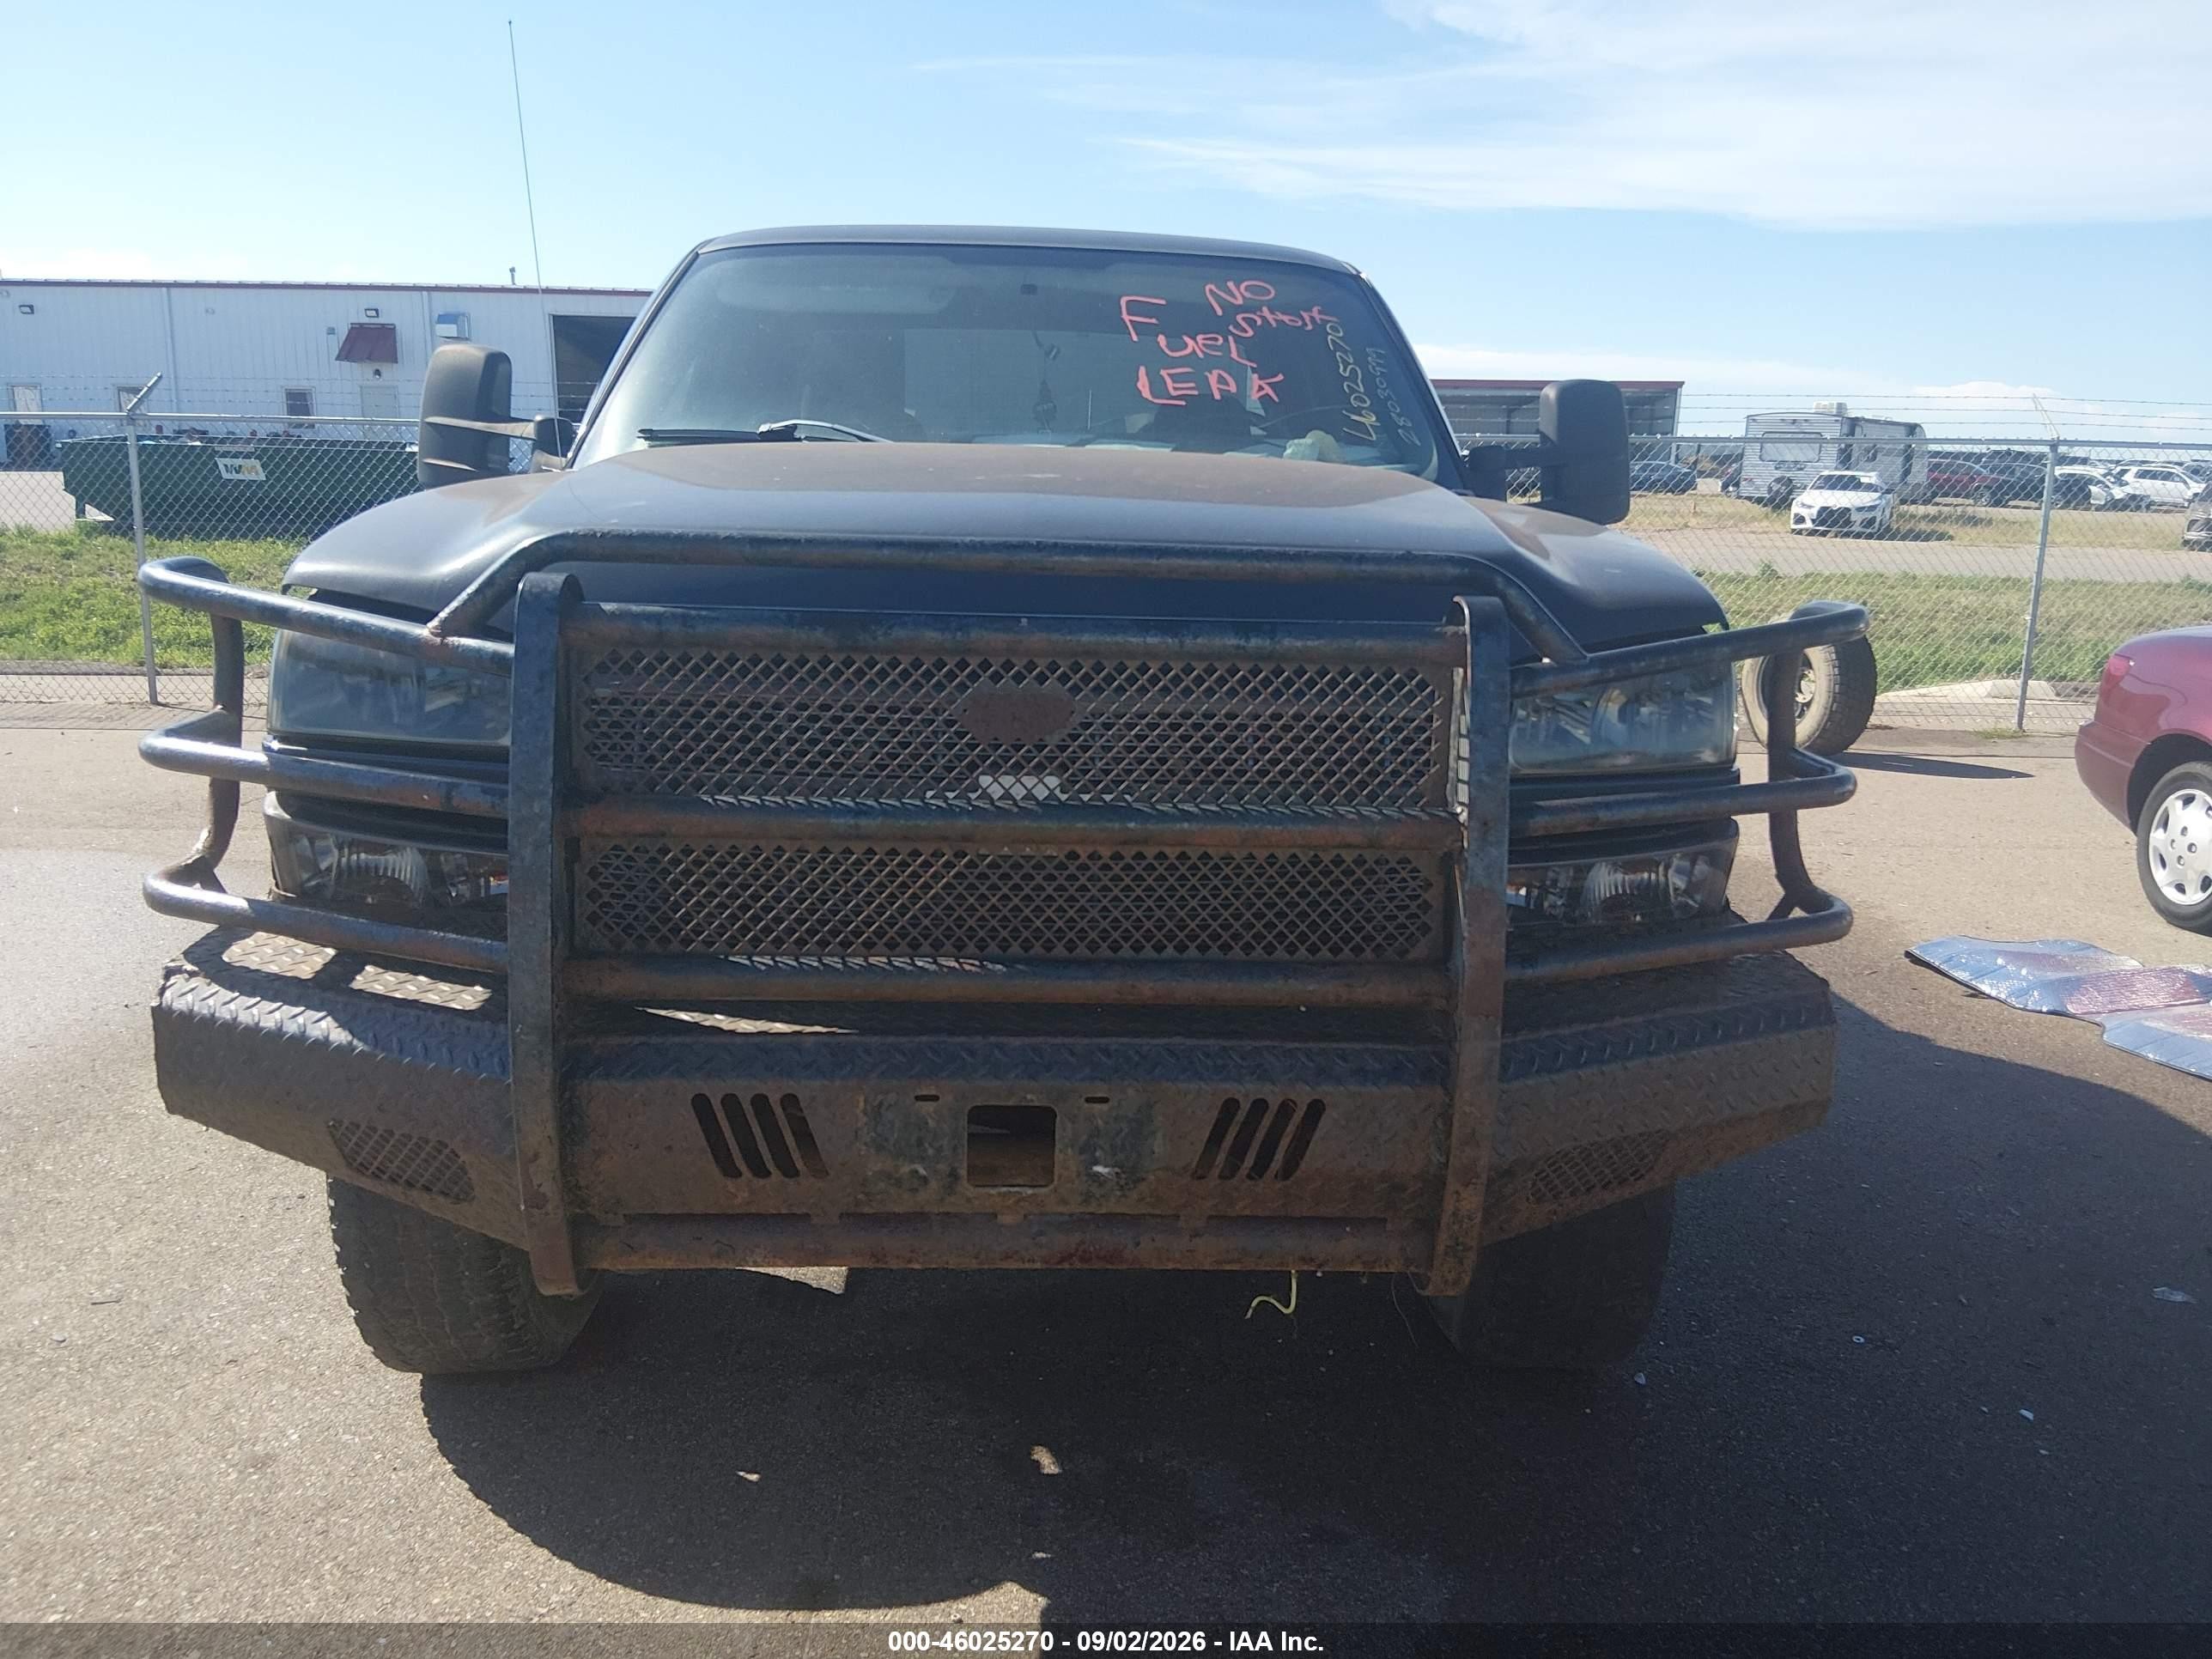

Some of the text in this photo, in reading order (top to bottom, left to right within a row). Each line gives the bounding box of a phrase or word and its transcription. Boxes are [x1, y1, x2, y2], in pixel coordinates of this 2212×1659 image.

[1205, 280, 1276, 316] NO
[1136, 365, 1285, 406] LEAK
[1325, 322, 1381, 441] 46025270
